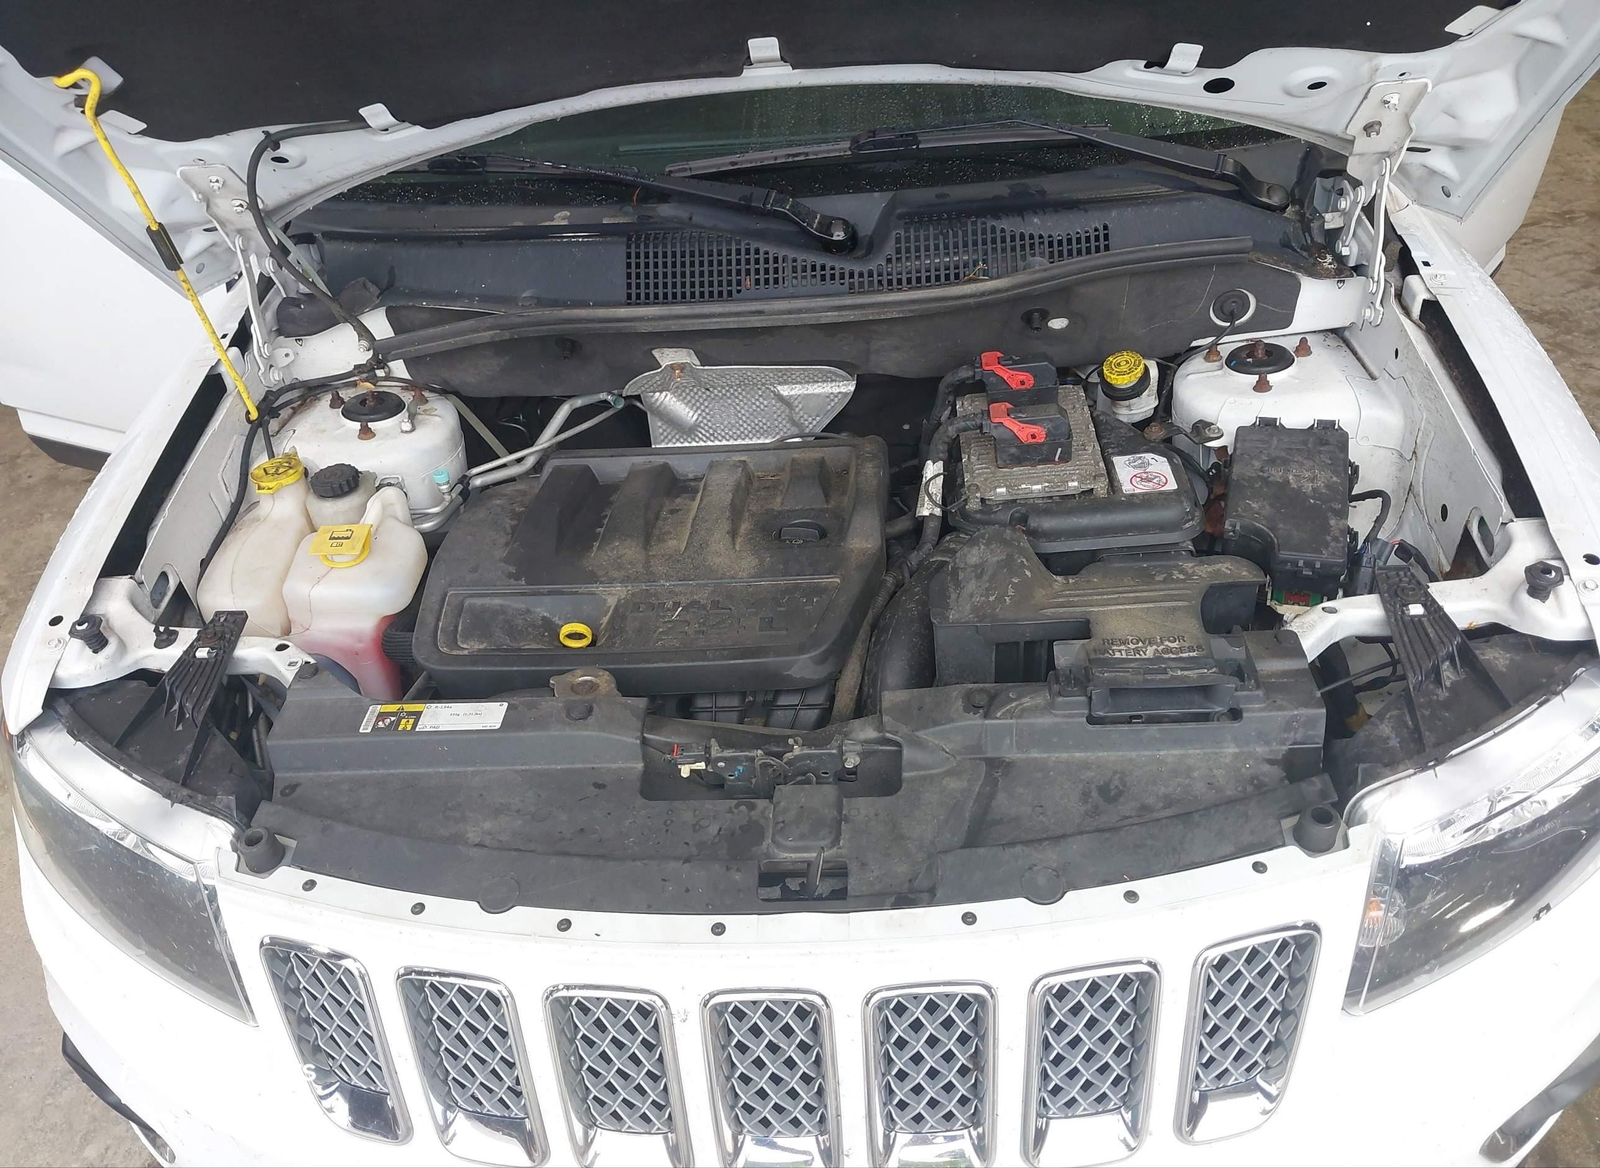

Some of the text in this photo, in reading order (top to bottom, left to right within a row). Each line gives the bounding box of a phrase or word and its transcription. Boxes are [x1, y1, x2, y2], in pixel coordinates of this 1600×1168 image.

[1102, 635, 1186, 646] REMOVE FOR
[1153, 645, 1205, 656] ACCESS
